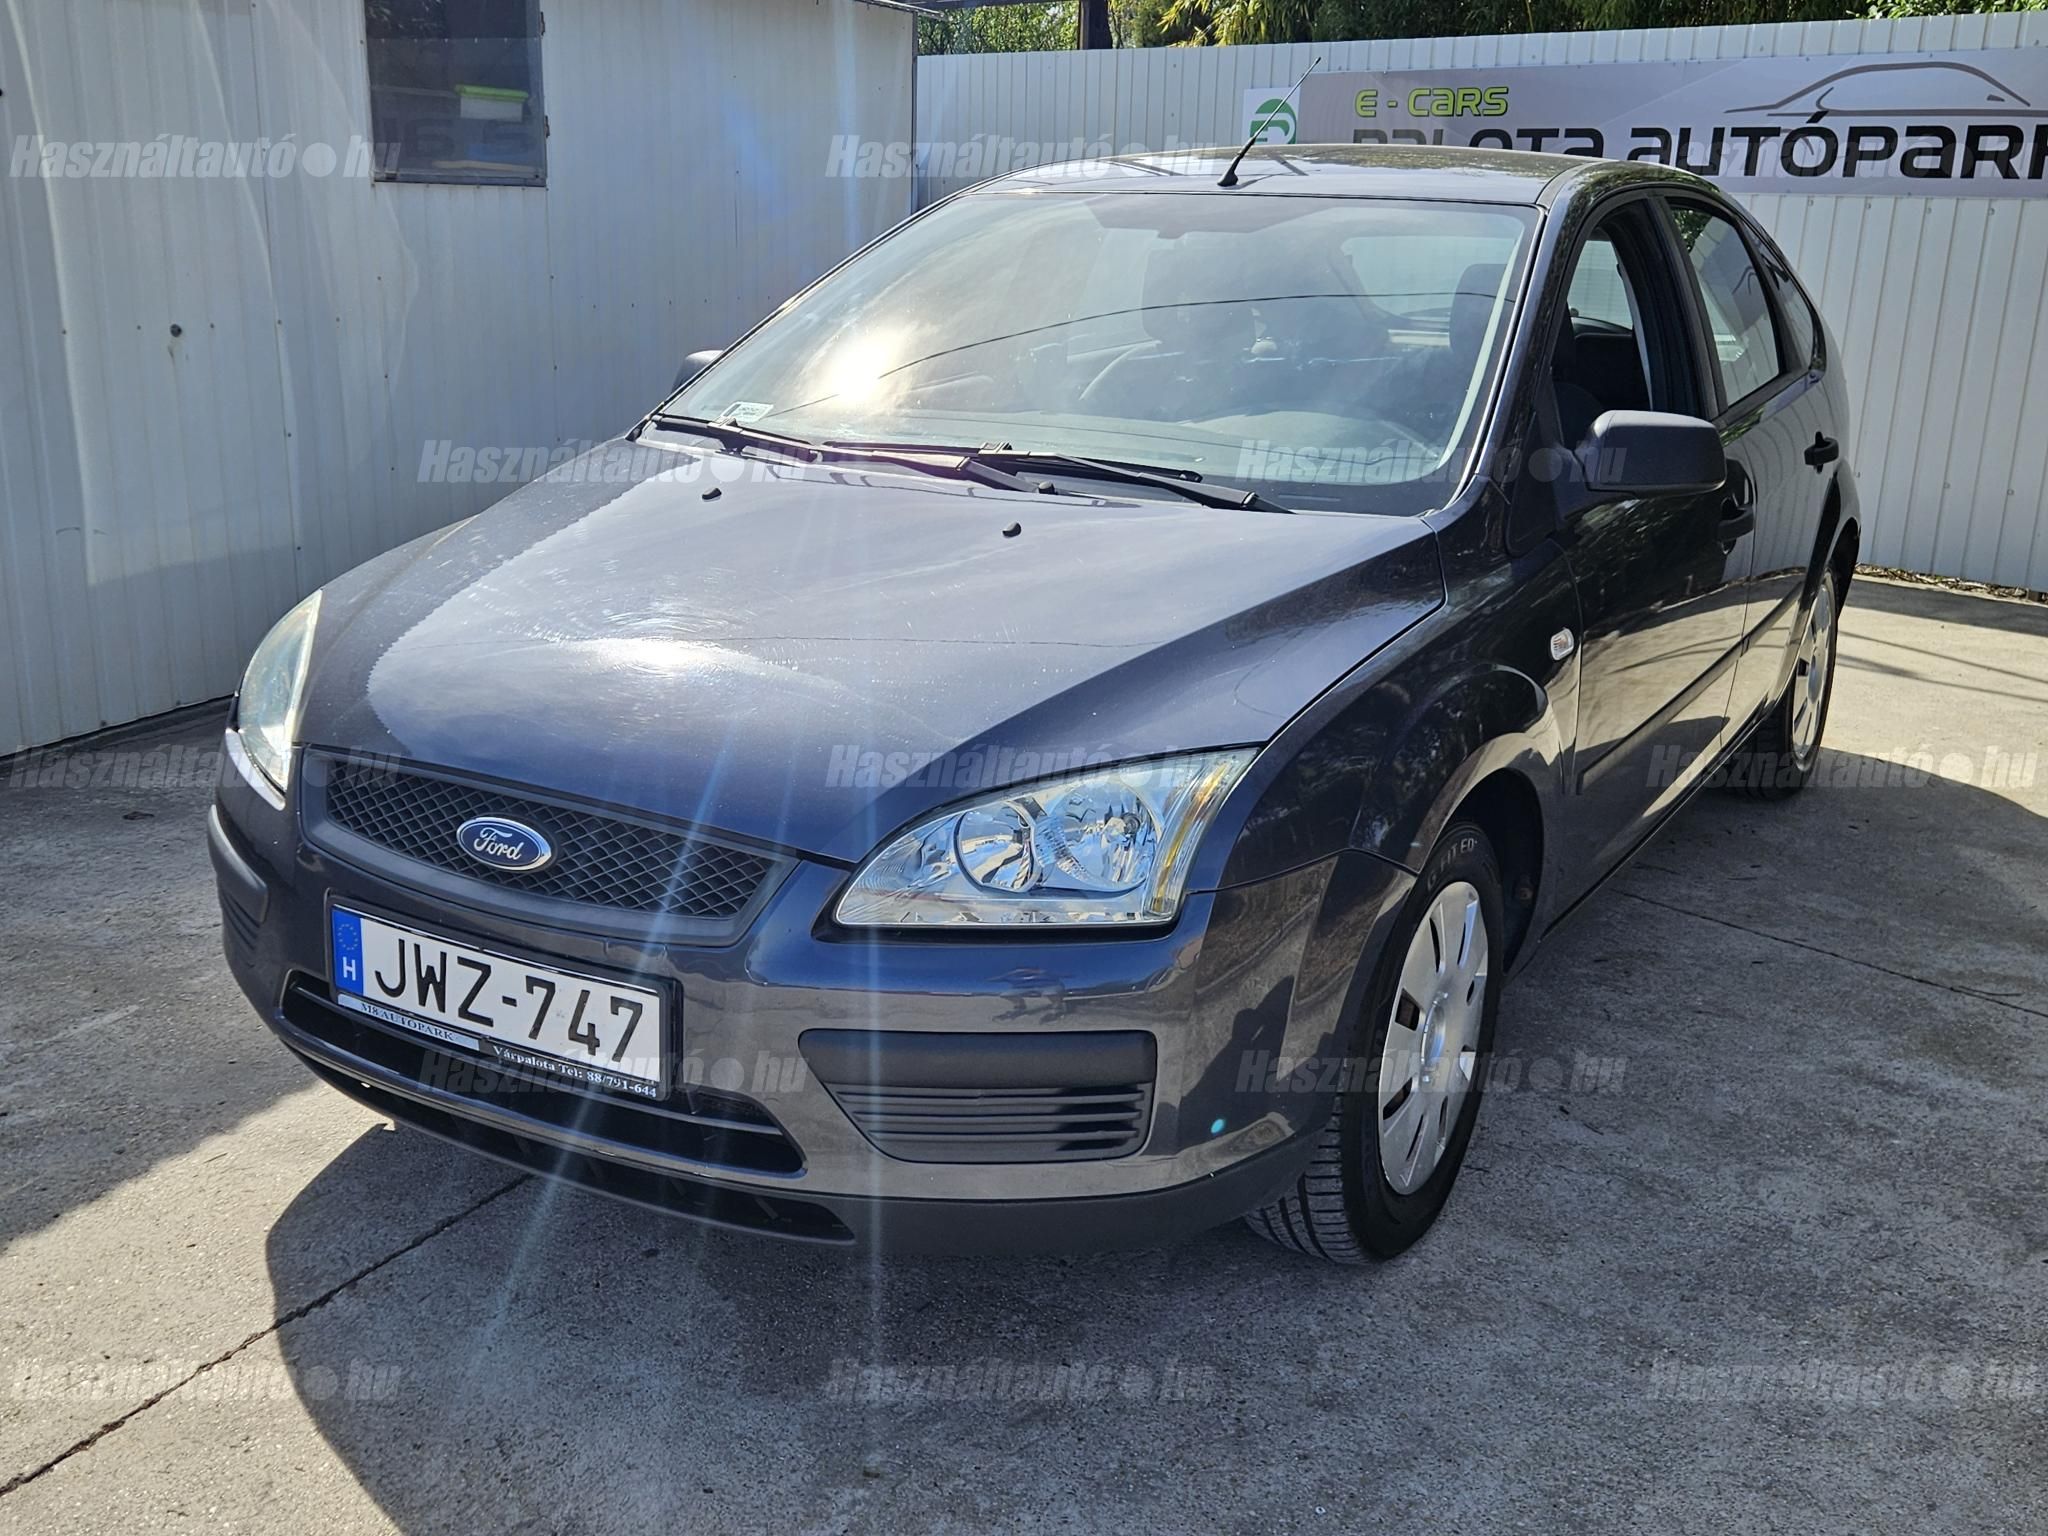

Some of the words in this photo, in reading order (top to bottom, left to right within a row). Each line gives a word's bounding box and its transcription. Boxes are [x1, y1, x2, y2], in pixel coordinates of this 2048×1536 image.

[473, 827, 525, 860] Ford
[342, 956, 356, 982] H
[374, 937, 644, 1063] JWZ-747
[493, 1045, 556, 1072] Várpalota
[558, 1063, 583, 1079] Tel:
[586, 1071, 657, 1098] 88/791-644
